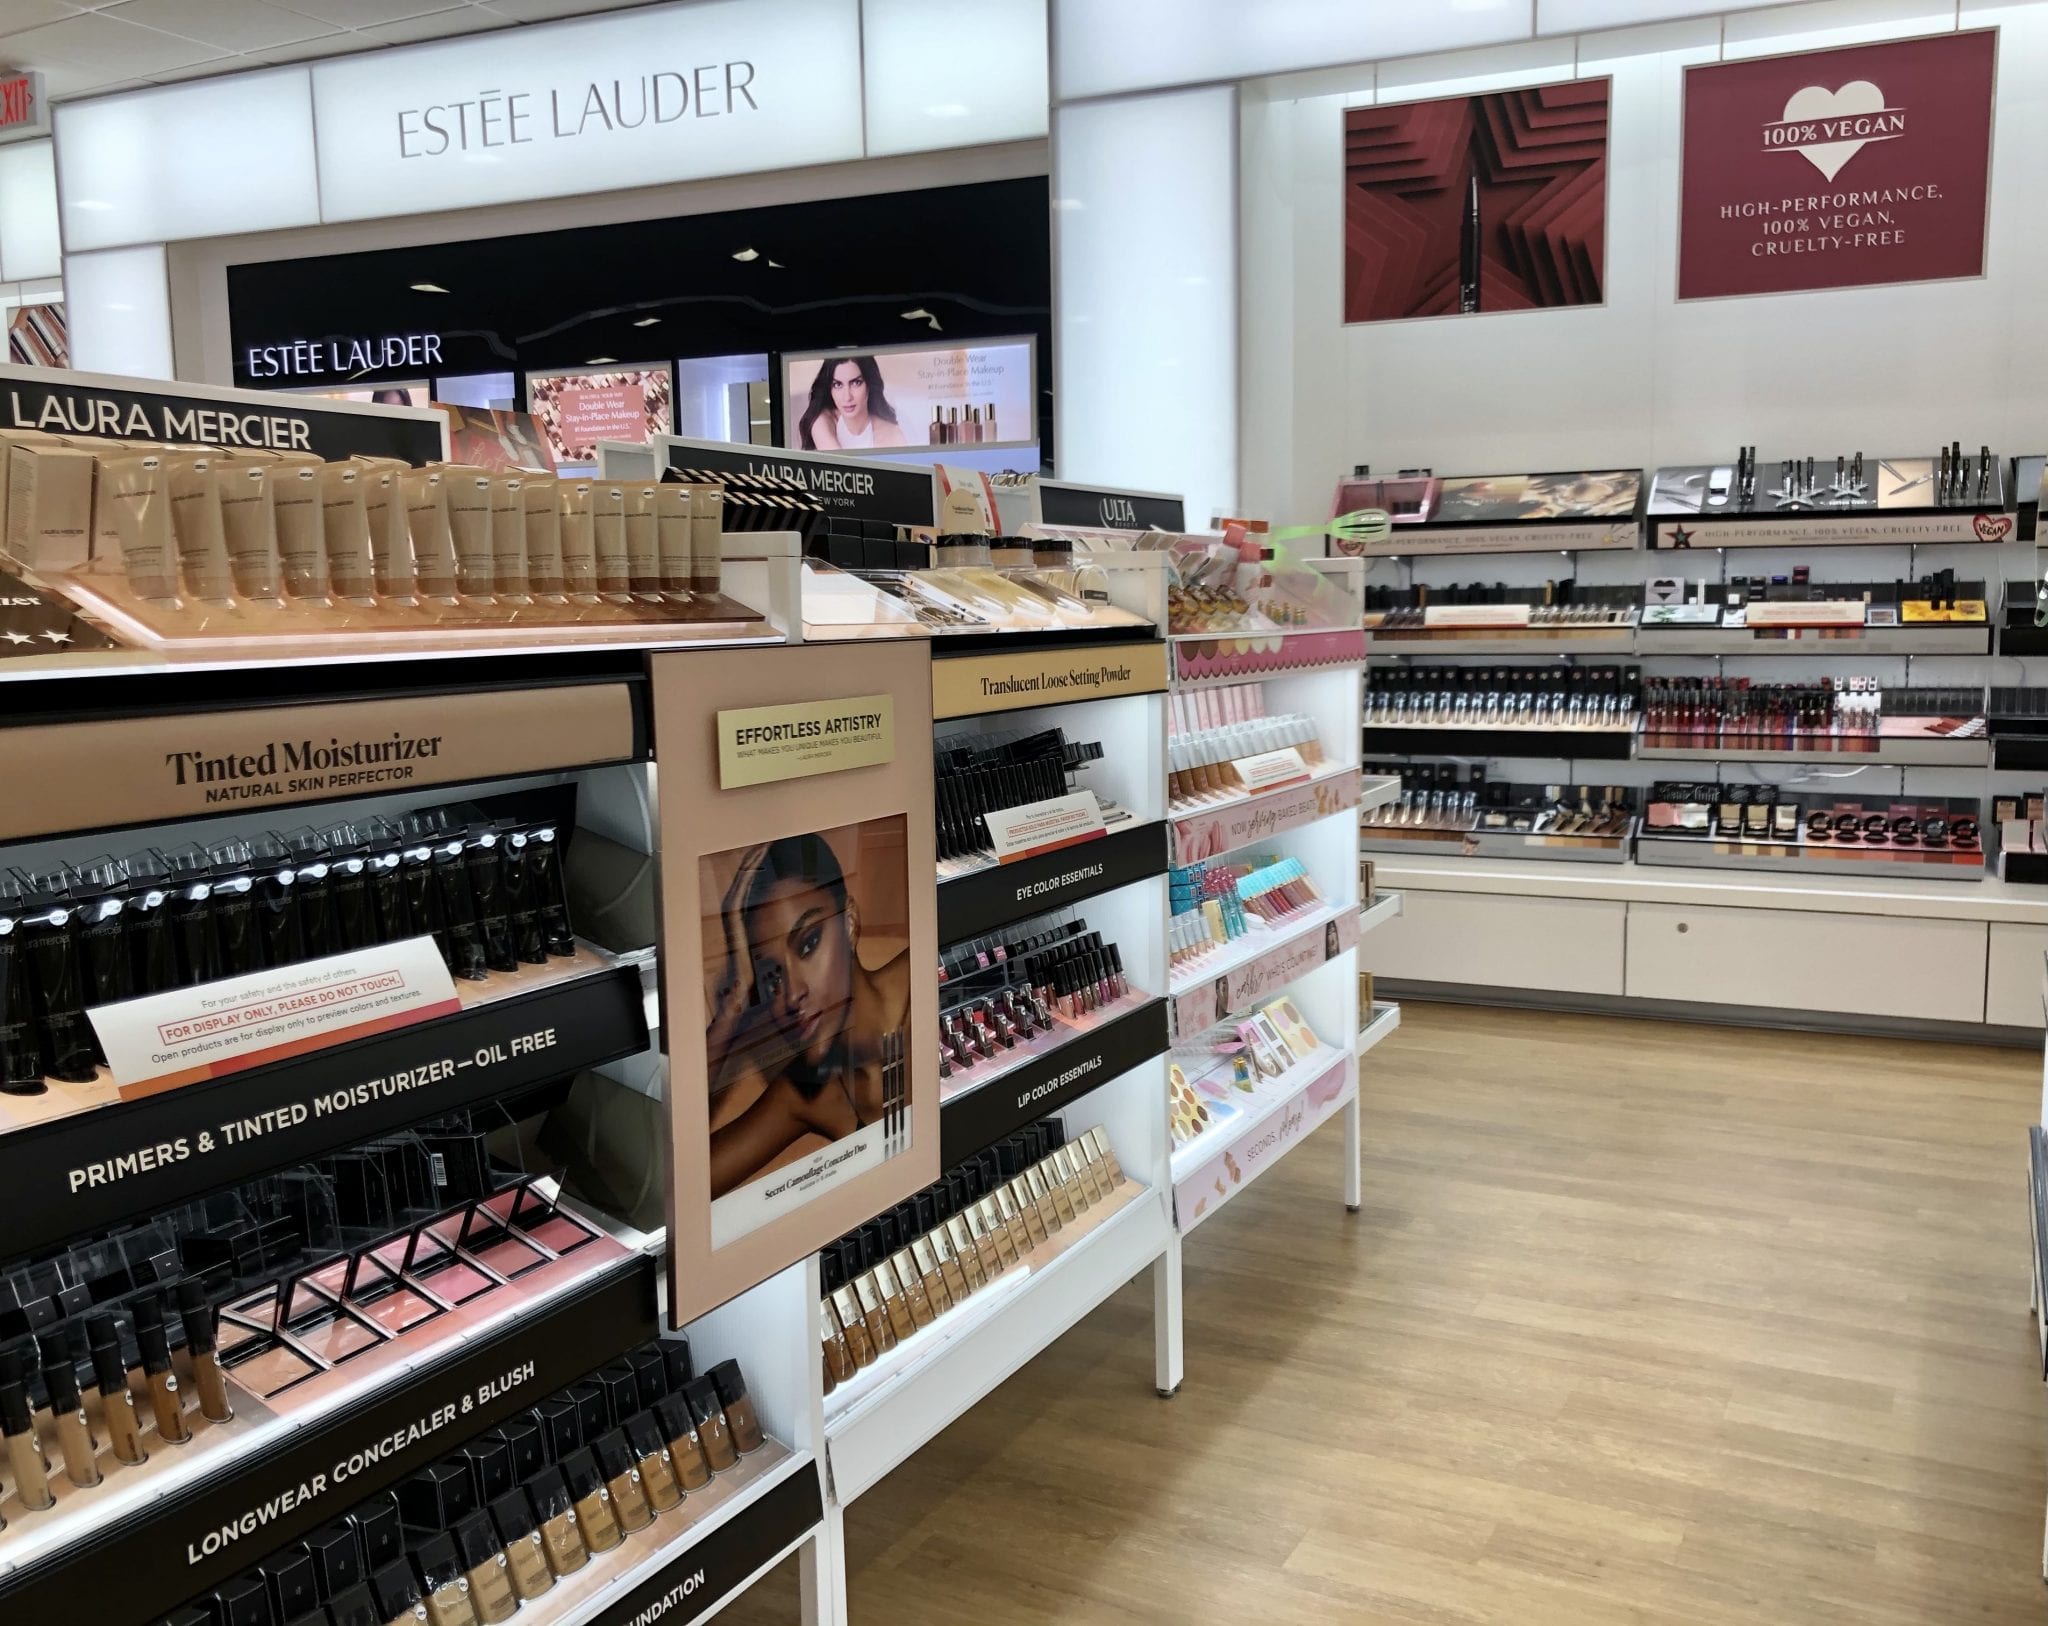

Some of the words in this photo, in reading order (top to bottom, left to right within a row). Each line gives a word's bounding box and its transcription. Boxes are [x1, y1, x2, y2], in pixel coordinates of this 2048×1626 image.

[0, 79, 28, 126] XIT
[551, 60, 758, 139] LAUDER
[1763, 124, 1817, 145] 100%
[1822, 115, 1905, 139] VEGAN
[1721, 184, 1943, 220] HIGH-PERFORMANCE,
[1763, 217, 1810, 235] 100%
[1819, 210, 1895, 230] VEGAN,
[1751, 230, 1905, 257] CRUELTY-FREE
[333, 333, 443, 372] LAUDER
[11, 391, 155, 438] LAURA
[162, 406, 312, 449] MERCIER
[565, 412, 610, 423] Stay-in-Place
[611, 410, 640, 420] Makeup
[579, 401, 605, 411] Double
[606, 400, 625, 409] Wear
[810, 469, 875, 495] MERCIER
[832, 497, 855, 508] YORK
[1103, 498, 1136, 522] ULTA
[1979, 522, 2004, 537] VEGAN
[980, 674, 1039, 696] Translucent
[1041, 672, 1068, 690] Loose
[1069, 667, 1100, 689] Setting
[1101, 664, 1131, 683] Powder
[736, 720, 821, 746] EFFORTLESS
[825, 713, 882, 735] ARTISTRY
[758, 746, 780, 756] MAKES
[782, 744, 795, 753] YOU
[795, 741, 819, 752] UNIQUE
[820, 738, 839, 748] MAKES
[840, 736, 853, 746] YOU
[166, 743, 277, 786] Tinted
[282, 732, 442, 774] Moisturizer
[205, 780, 284, 803] NATURAL
[288, 775, 325, 793] SKIN
[329, 766, 414, 788] PERFECTOR
[1017, 886, 1032, 901] EYE
[1033, 876, 1060, 895] COLOR
[1061, 863, 1103, 886] ESSENTIALS
[202, 1000, 216, 1009] For
[219, 996, 238, 1007] your
[239, 988, 265, 1003] safety
[267, 984, 282, 993] and
[283, 980, 297, 989] the
[299, 974, 323, 989] safety
[324, 972, 332, 981] of
[332, 966, 357, 978] others
[152, 1052, 179, 1064] Open
[181, 1040, 223, 1057] products
[224, 1036, 239, 1045] are
[240, 1030, 254, 1041] for
[255, 1022, 285, 1040] display
[287, 1017, 305, 1033] only
[306, 1014, 315, 1024] to
[317, 1008, 348, 1024] preview
[350, 1000, 374, 1013] colors
[375, 996, 389, 1007] and
[391, 988, 422, 1003] textures.
[166, 1026, 191, 1040] FOR
[194, 1014, 240, 1034] DISPLAY
[244, 1005, 278, 1021] ONLY,
[279, 997, 317, 1013] PLEASE
[319, 993, 335, 1004] DO
[337, 987, 359, 999] NOT
[360, 975, 400, 993] TOUCH.
[1018, 1092, 1031, 1108] LIP
[1032, 1078, 1059, 1101] COLOR
[1060, 1055, 1103, 1086] ESSENTIALS
[69, 1137, 190, 1194] PRIMERS
[198, 1130, 216, 1154] &
[221, 1103, 308, 1146] TINTED
[511, 1027, 557, 1056] FREE
[764, 1183, 786, 1201] Secret
[786, 1164, 824, 1190] Camouflage
[824, 1148, 854, 1171] Concealer
[854, 1143, 867, 1156] Duo
[187, 1473, 327, 1566] LONGWEAR
[333, 1406, 456, 1484] CONCEALER
[461, 1395, 473, 1414] &
[478, 1360, 535, 1404] BLUSH
